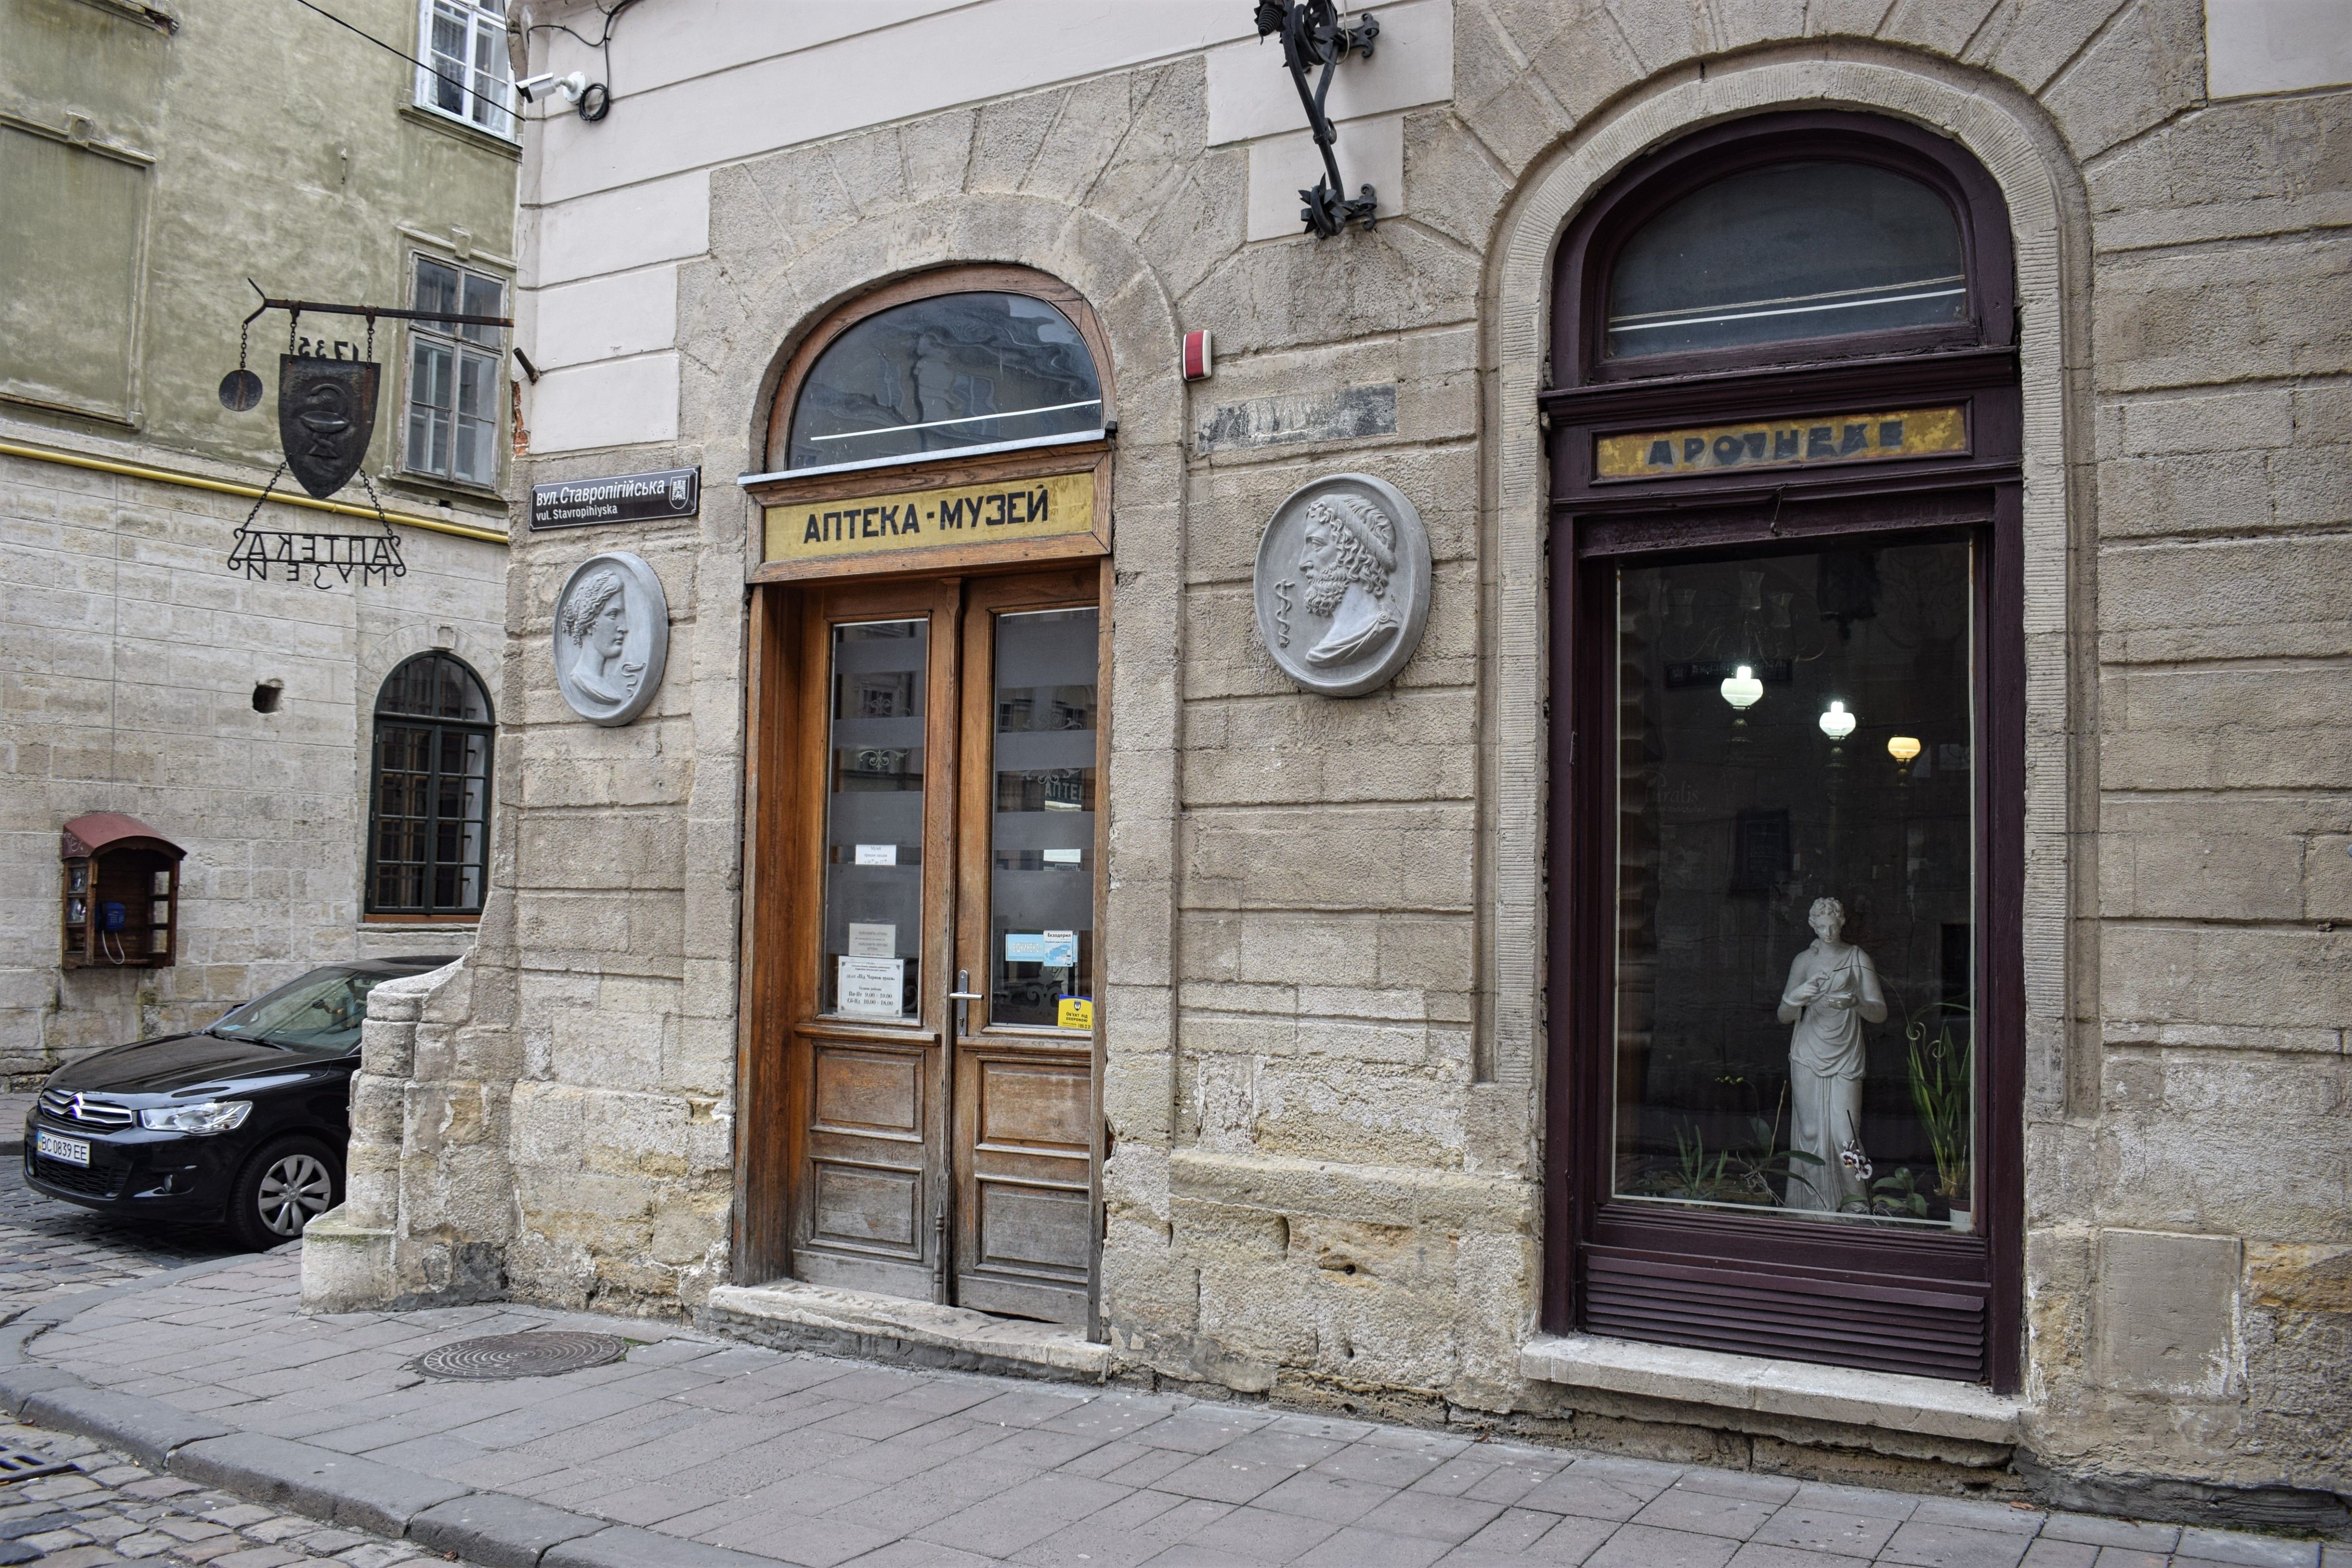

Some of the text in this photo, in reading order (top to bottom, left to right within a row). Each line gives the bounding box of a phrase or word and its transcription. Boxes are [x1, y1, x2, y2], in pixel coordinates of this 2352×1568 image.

[1648, 421, 1903, 465] APOTHEKE
[536, 480, 665, 506] вул. Ставропігійська
[536, 504, 618, 521] vul. Stavropihiyska
[1045, 781, 1082, 801] АПТЕ
[1012, 943, 1040, 955] ВІДЧИНЕНО
[42, 1136, 87, 1161] BC 0839 EE
